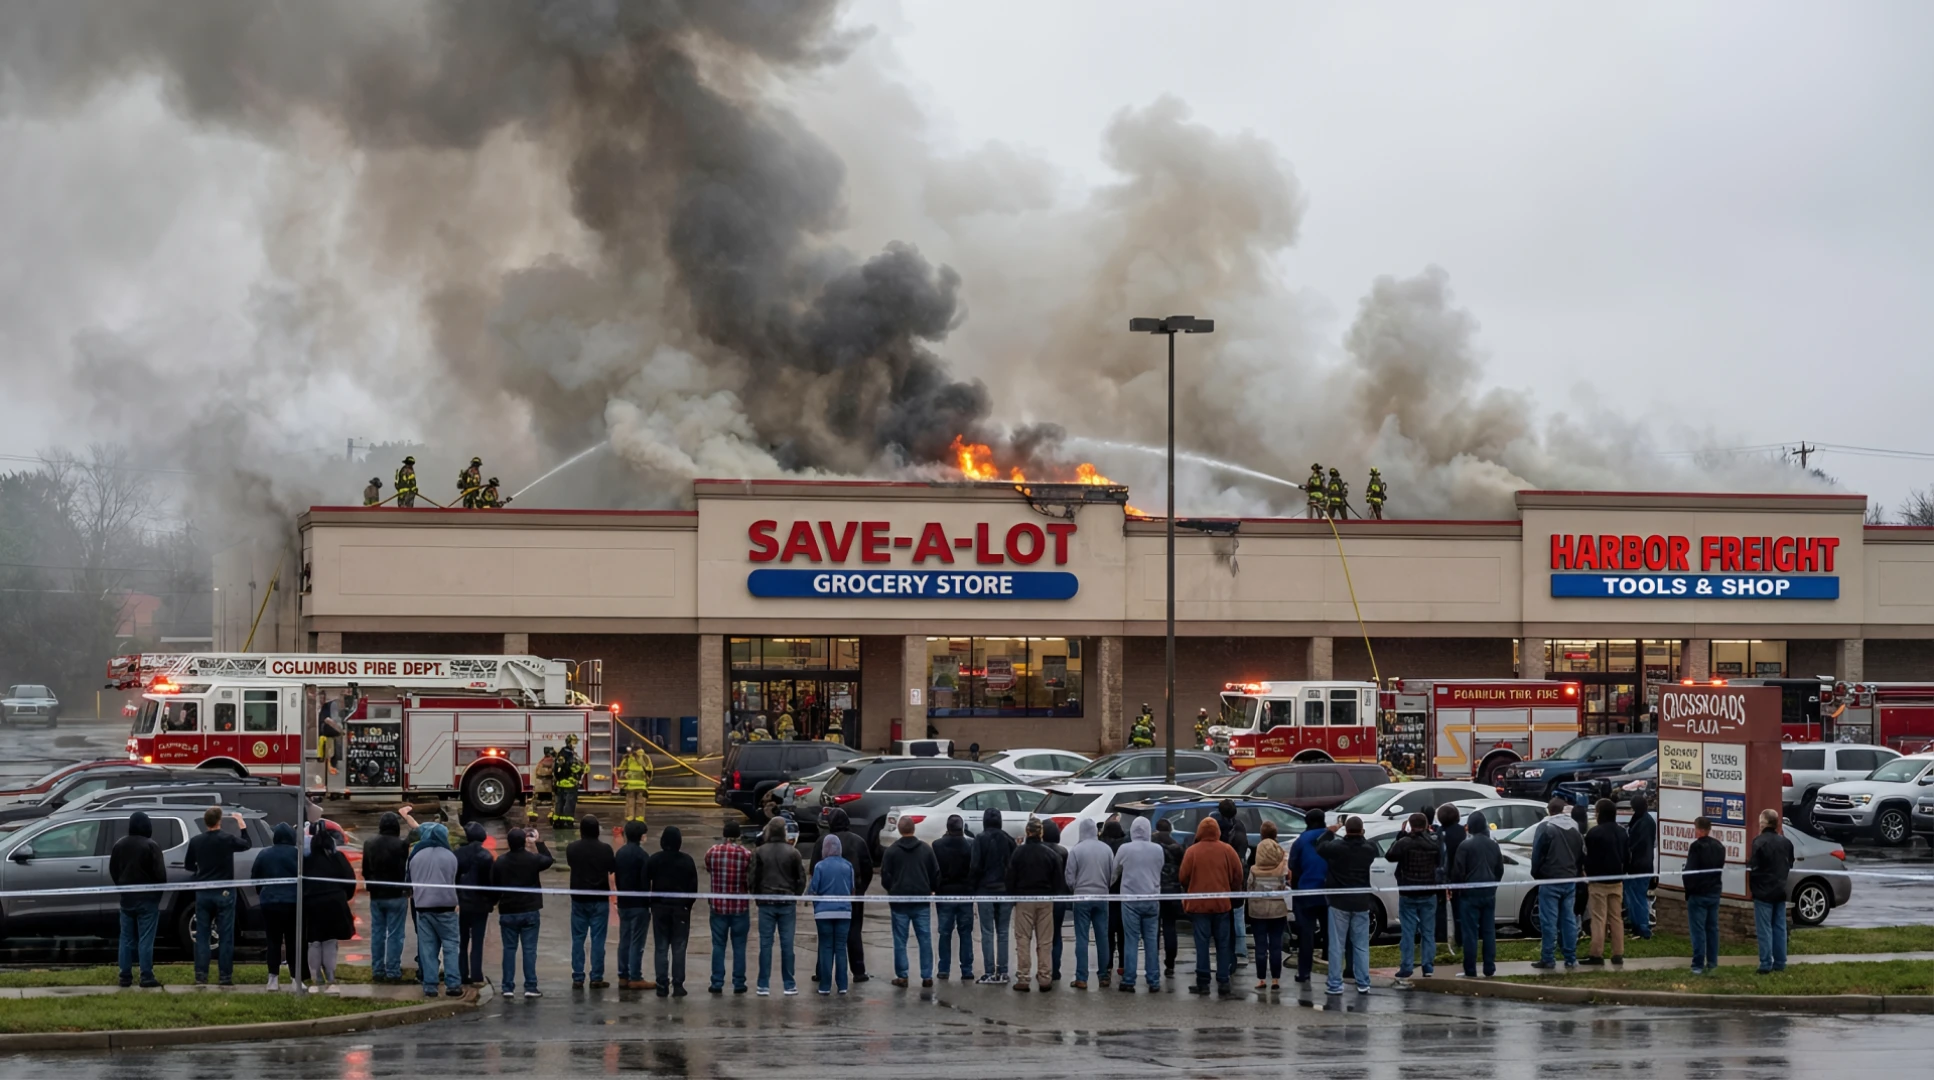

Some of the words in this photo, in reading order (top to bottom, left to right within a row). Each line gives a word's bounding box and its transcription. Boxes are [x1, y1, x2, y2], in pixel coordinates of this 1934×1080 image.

[748, 519, 1077, 565] SAVE-A-LOT
[1550, 534, 1690, 571] HARBOR
[1701, 536, 1839, 572] FREIGHT
[813, 574, 929, 594] GROCERY
[936, 575, 1013, 594] STORE
[1602, 577, 1687, 595] TOOLS
[1695, 578, 1713, 595] &
[1721, 578, 1791, 596] SHOP
[403, 661, 445, 676] DEPT.
